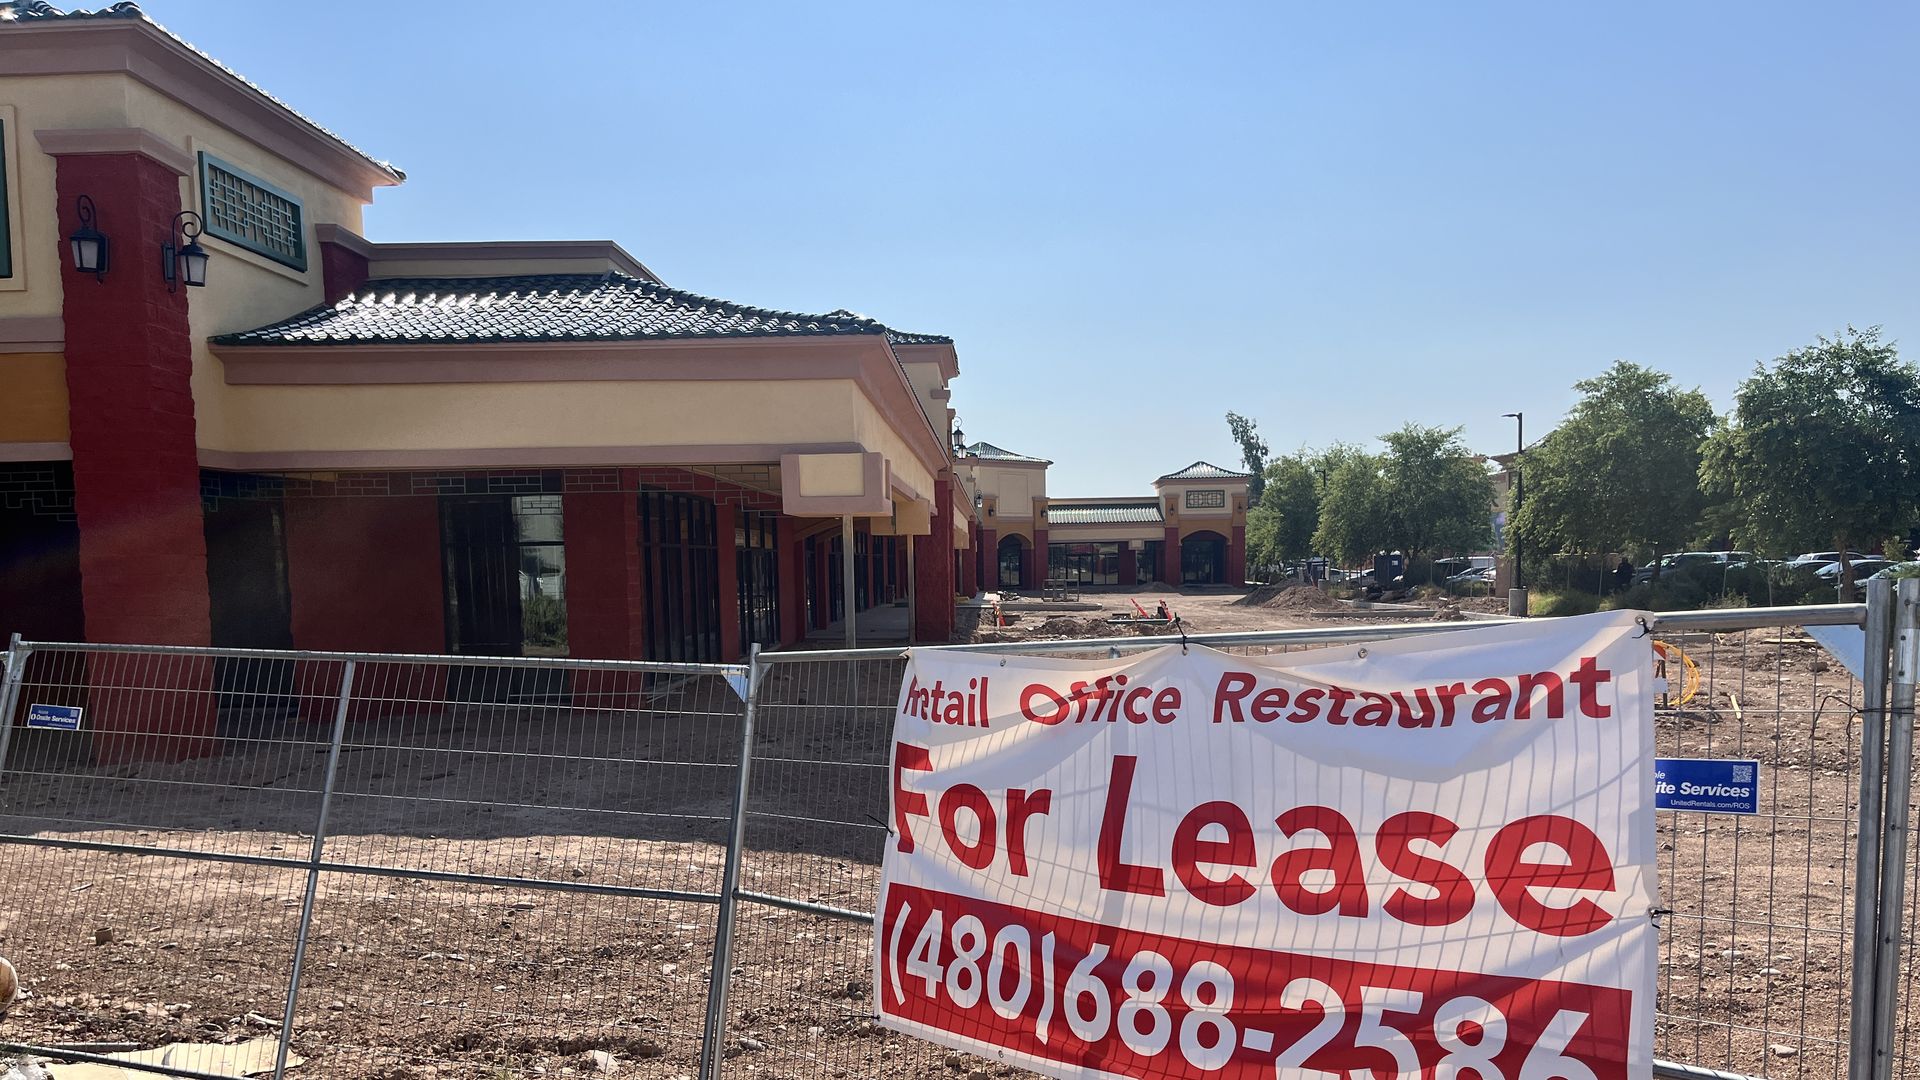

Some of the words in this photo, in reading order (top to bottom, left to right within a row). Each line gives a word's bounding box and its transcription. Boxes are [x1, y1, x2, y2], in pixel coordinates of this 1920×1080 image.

[1019, 674, 1181, 726] Office
[1213, 656, 1611, 728] Restaurant
[51, 715, 76, 724] Services
[1655, 781, 1676, 794] ite
[1680, 781, 1750, 798] Services
[1671, 799, 1750, 810] UnitedRentals.com/ROS
[893, 741, 1052, 877] For
[1097, 755, 1616, 937] Lease
